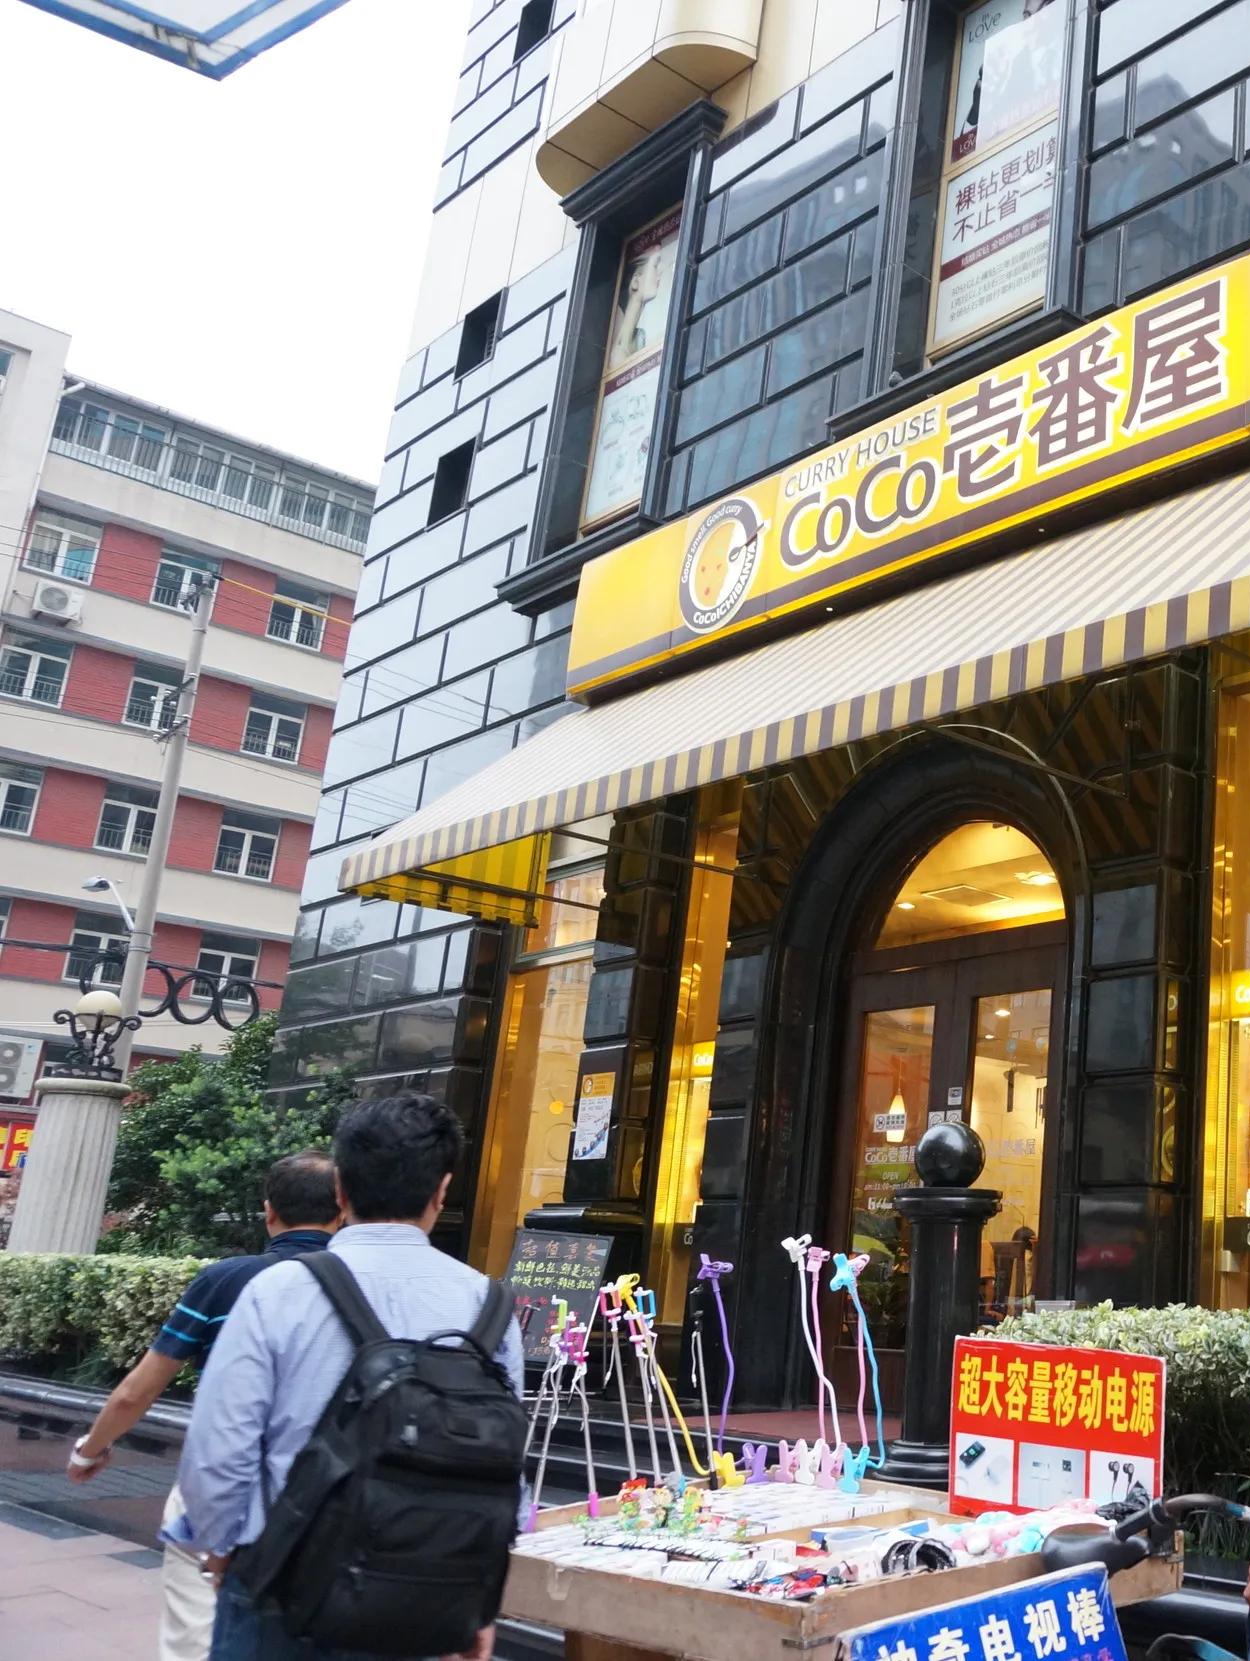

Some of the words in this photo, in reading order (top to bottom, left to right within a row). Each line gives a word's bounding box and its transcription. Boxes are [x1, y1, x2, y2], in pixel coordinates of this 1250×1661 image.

[785, 447, 850, 498] CURRY
[856, 407, 937, 467] HOUSE
[780, 453, 937, 567] CoCo
[882, 1171, 899, 1181] OPEN
[958, 1352, 1155, 1438] 超大容量移动电源
